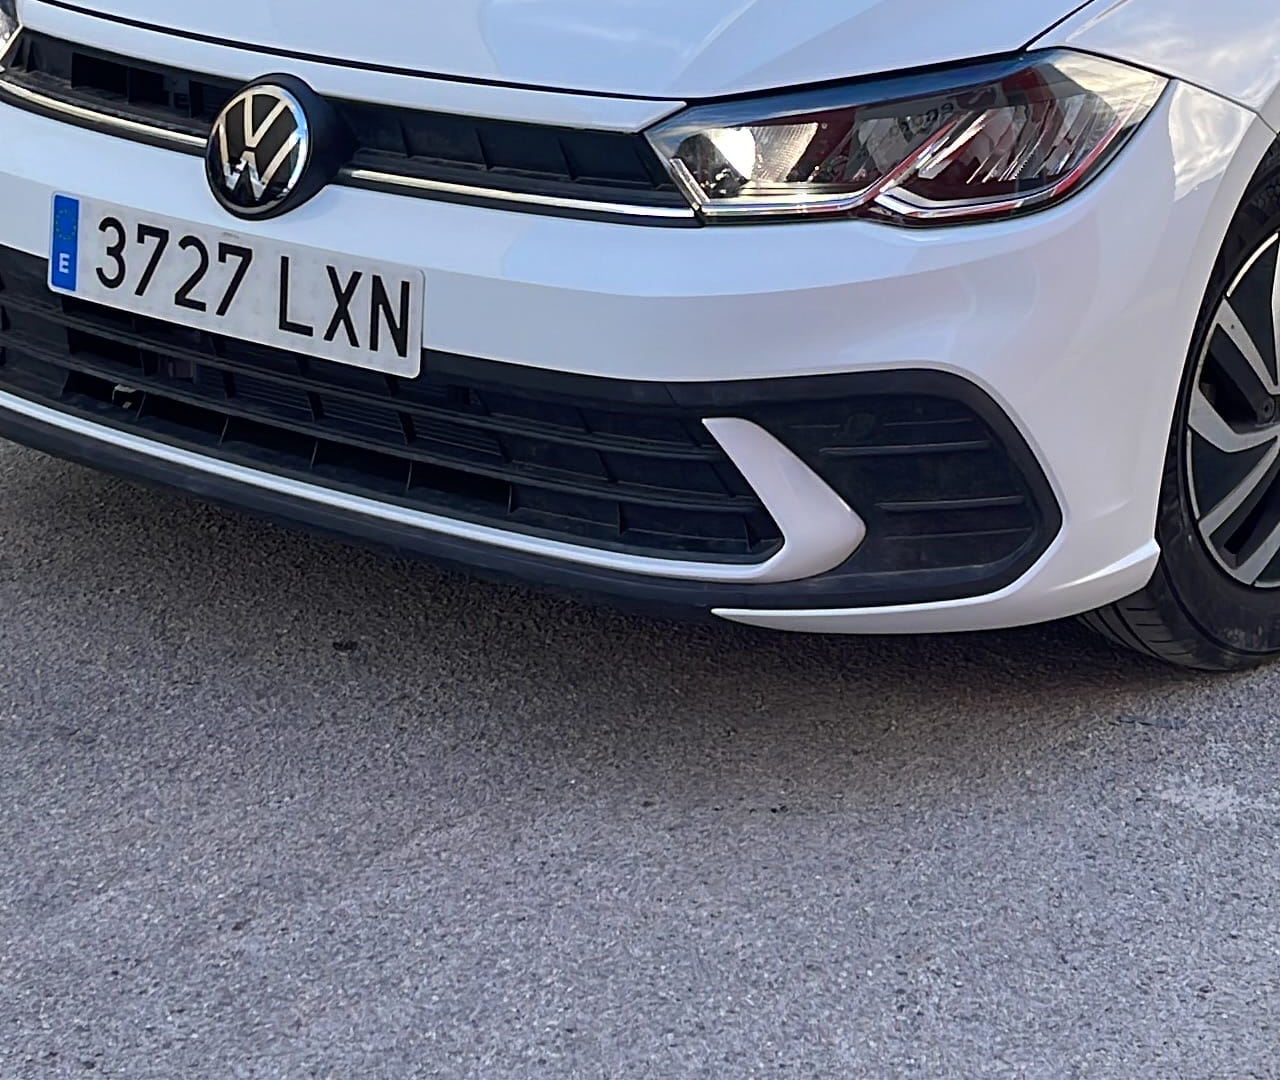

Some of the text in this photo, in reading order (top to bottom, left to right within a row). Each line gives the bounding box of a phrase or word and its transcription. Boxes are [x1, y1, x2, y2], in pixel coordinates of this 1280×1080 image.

[58, 253, 70, 274] E
[96, 217, 410, 358] 3727 LXN
